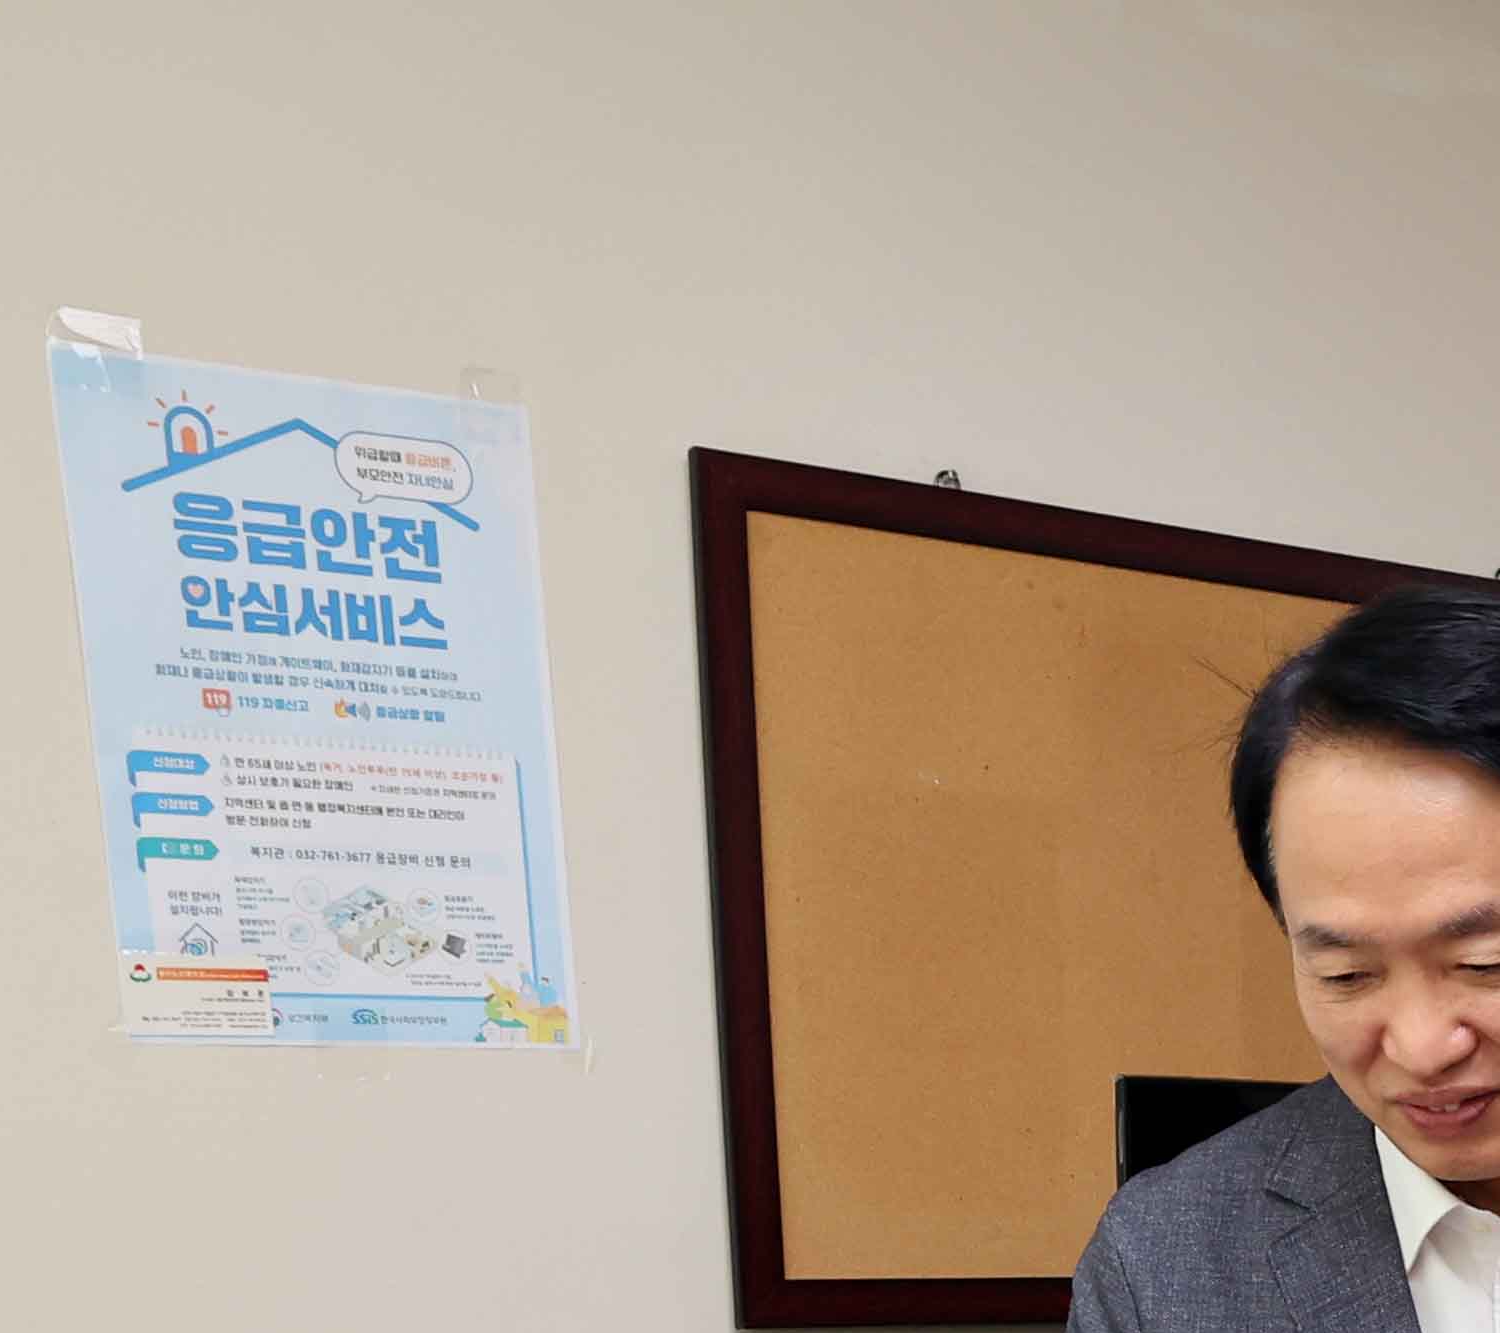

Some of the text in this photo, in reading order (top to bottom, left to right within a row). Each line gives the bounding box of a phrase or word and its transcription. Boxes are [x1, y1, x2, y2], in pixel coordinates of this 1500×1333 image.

[172, 491, 443, 584] 응급안전
[180, 575, 449, 650] 안심서비스
[237, 695, 260, 709] 119
[250, 846, 286, 861] 복지관
[295, 848, 372, 864] 032-761-3677
